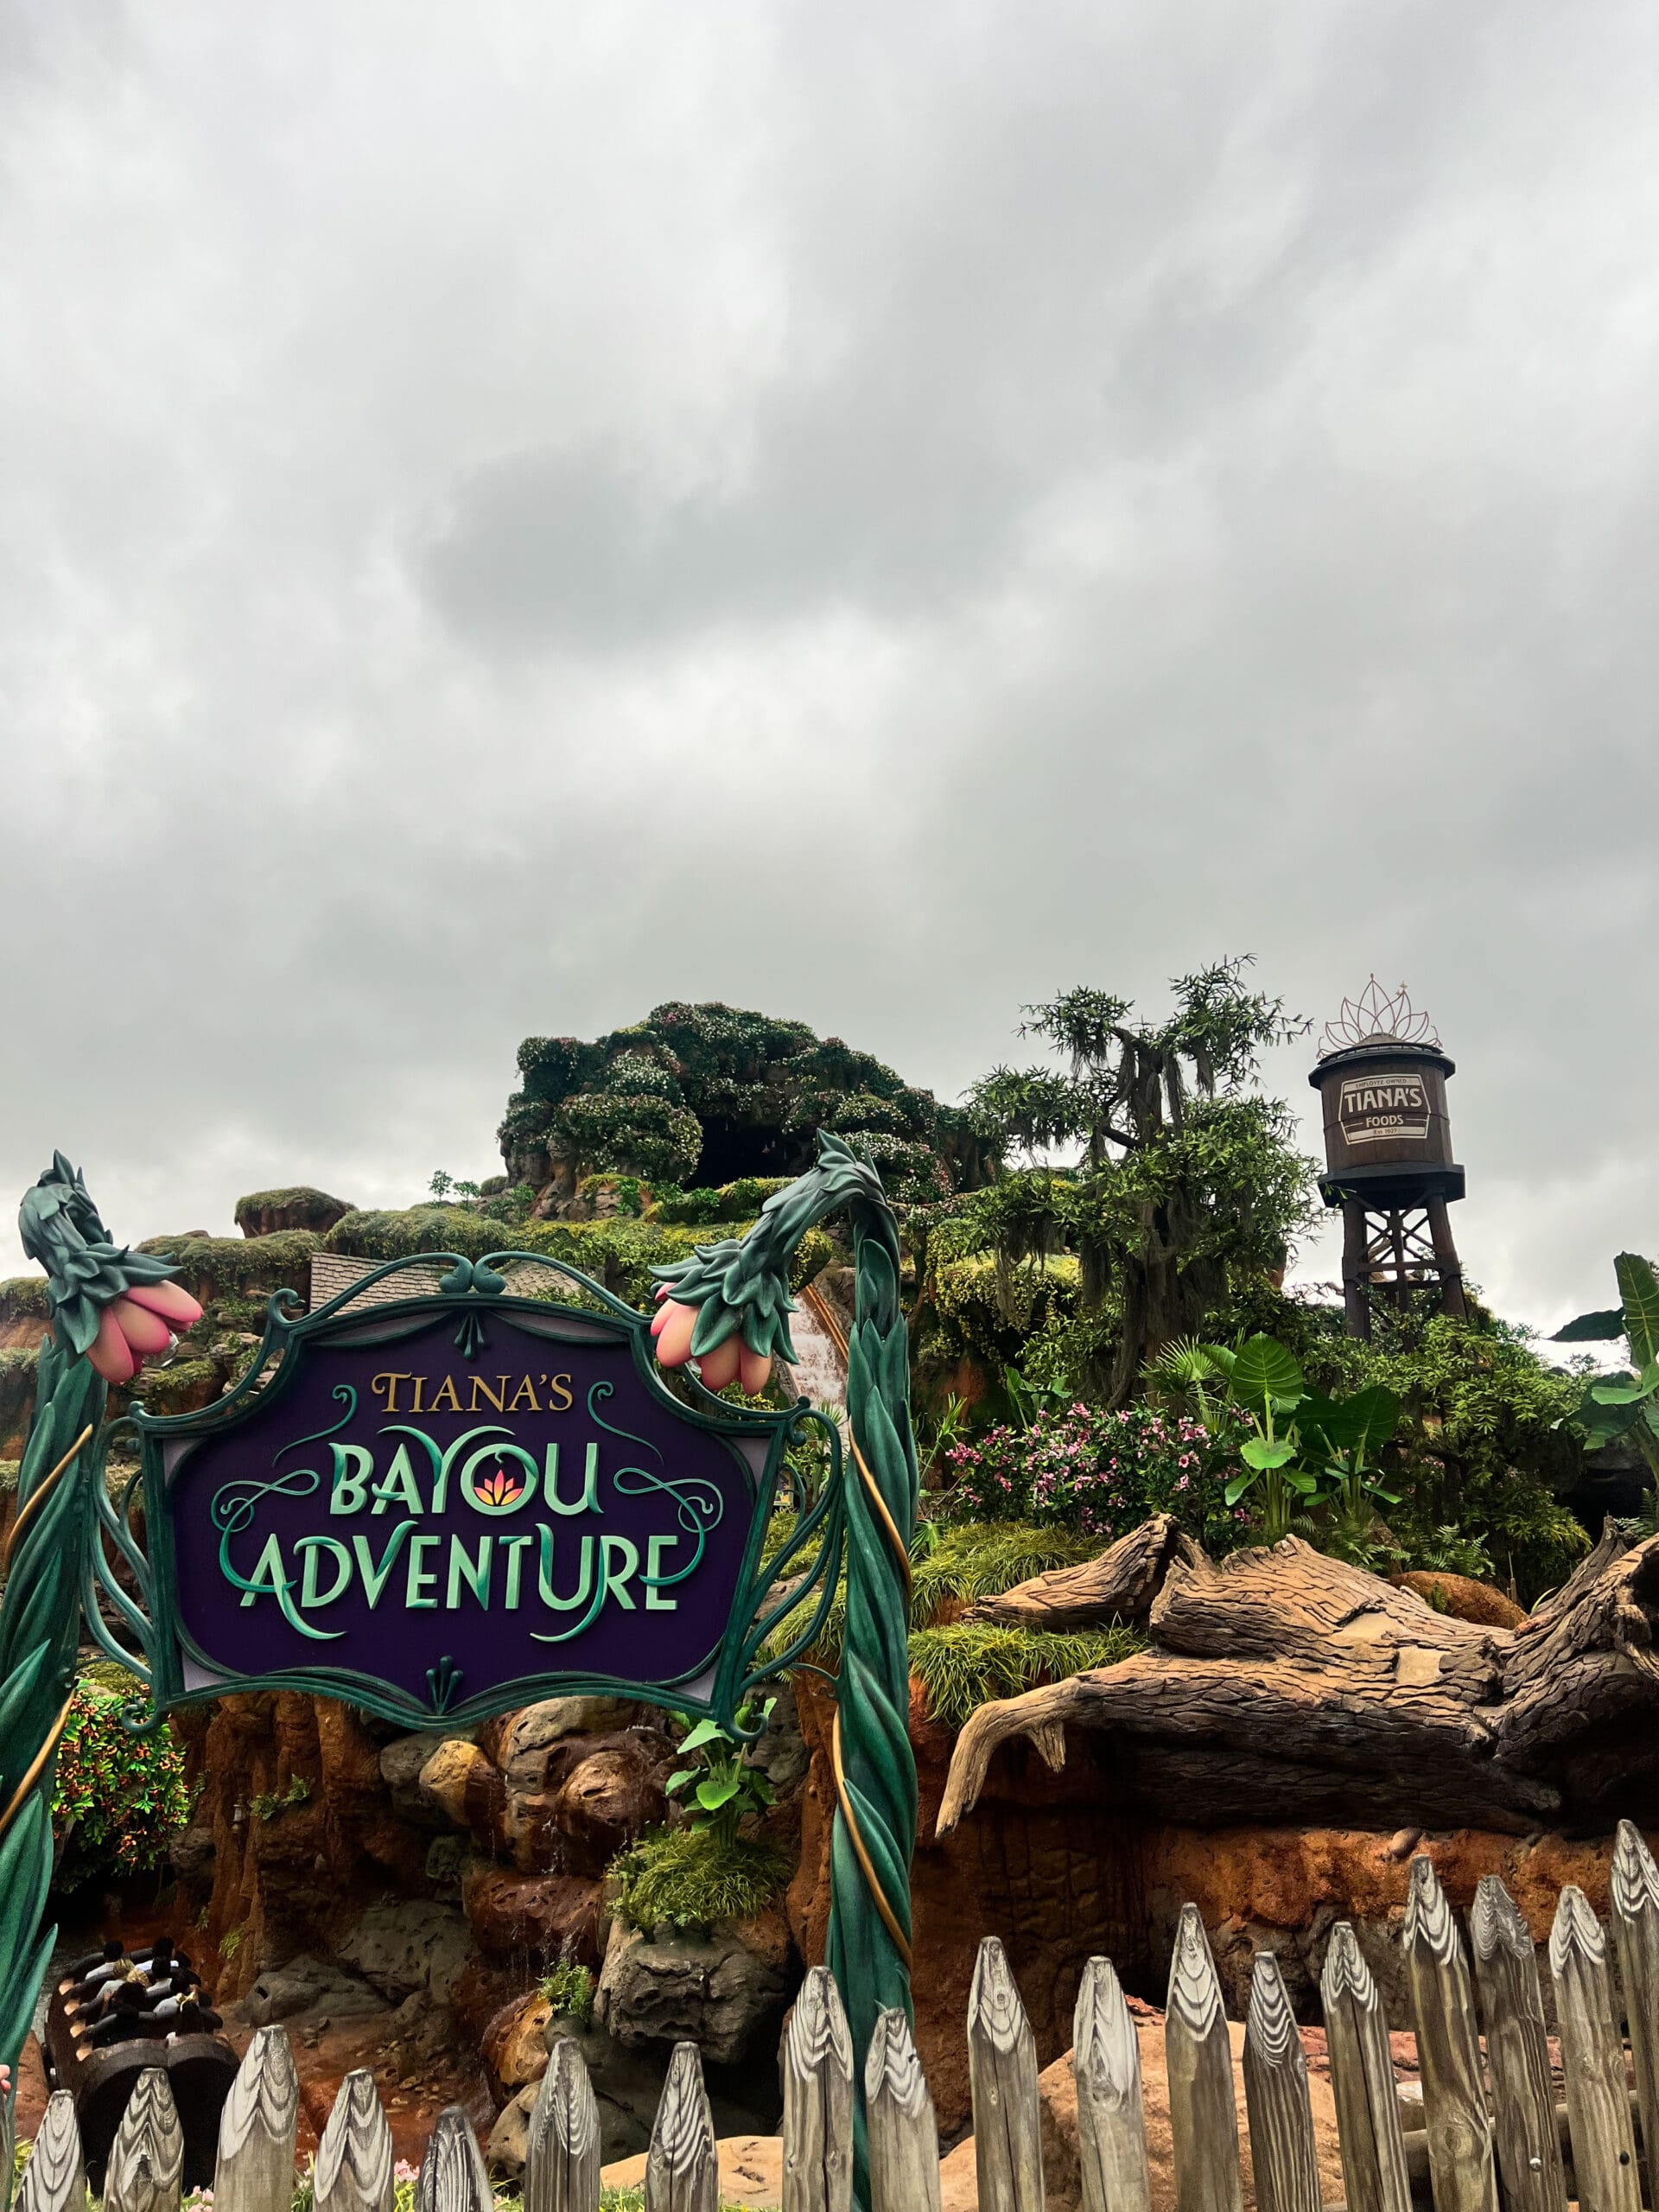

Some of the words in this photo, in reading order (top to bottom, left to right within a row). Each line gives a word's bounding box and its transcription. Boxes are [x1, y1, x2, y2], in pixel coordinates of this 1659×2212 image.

[1344, 1088, 1422, 1113] TIANA'S
[1356, 1079, 1383, 1089] EMPLOYEE
[1366, 1115, 1404, 1128] FOODS
[371, 1372, 575, 1414] TIANA'S
[328, 1425, 604, 1516] BAYOU
[233, 1520, 680, 1642] ADVENTURE
